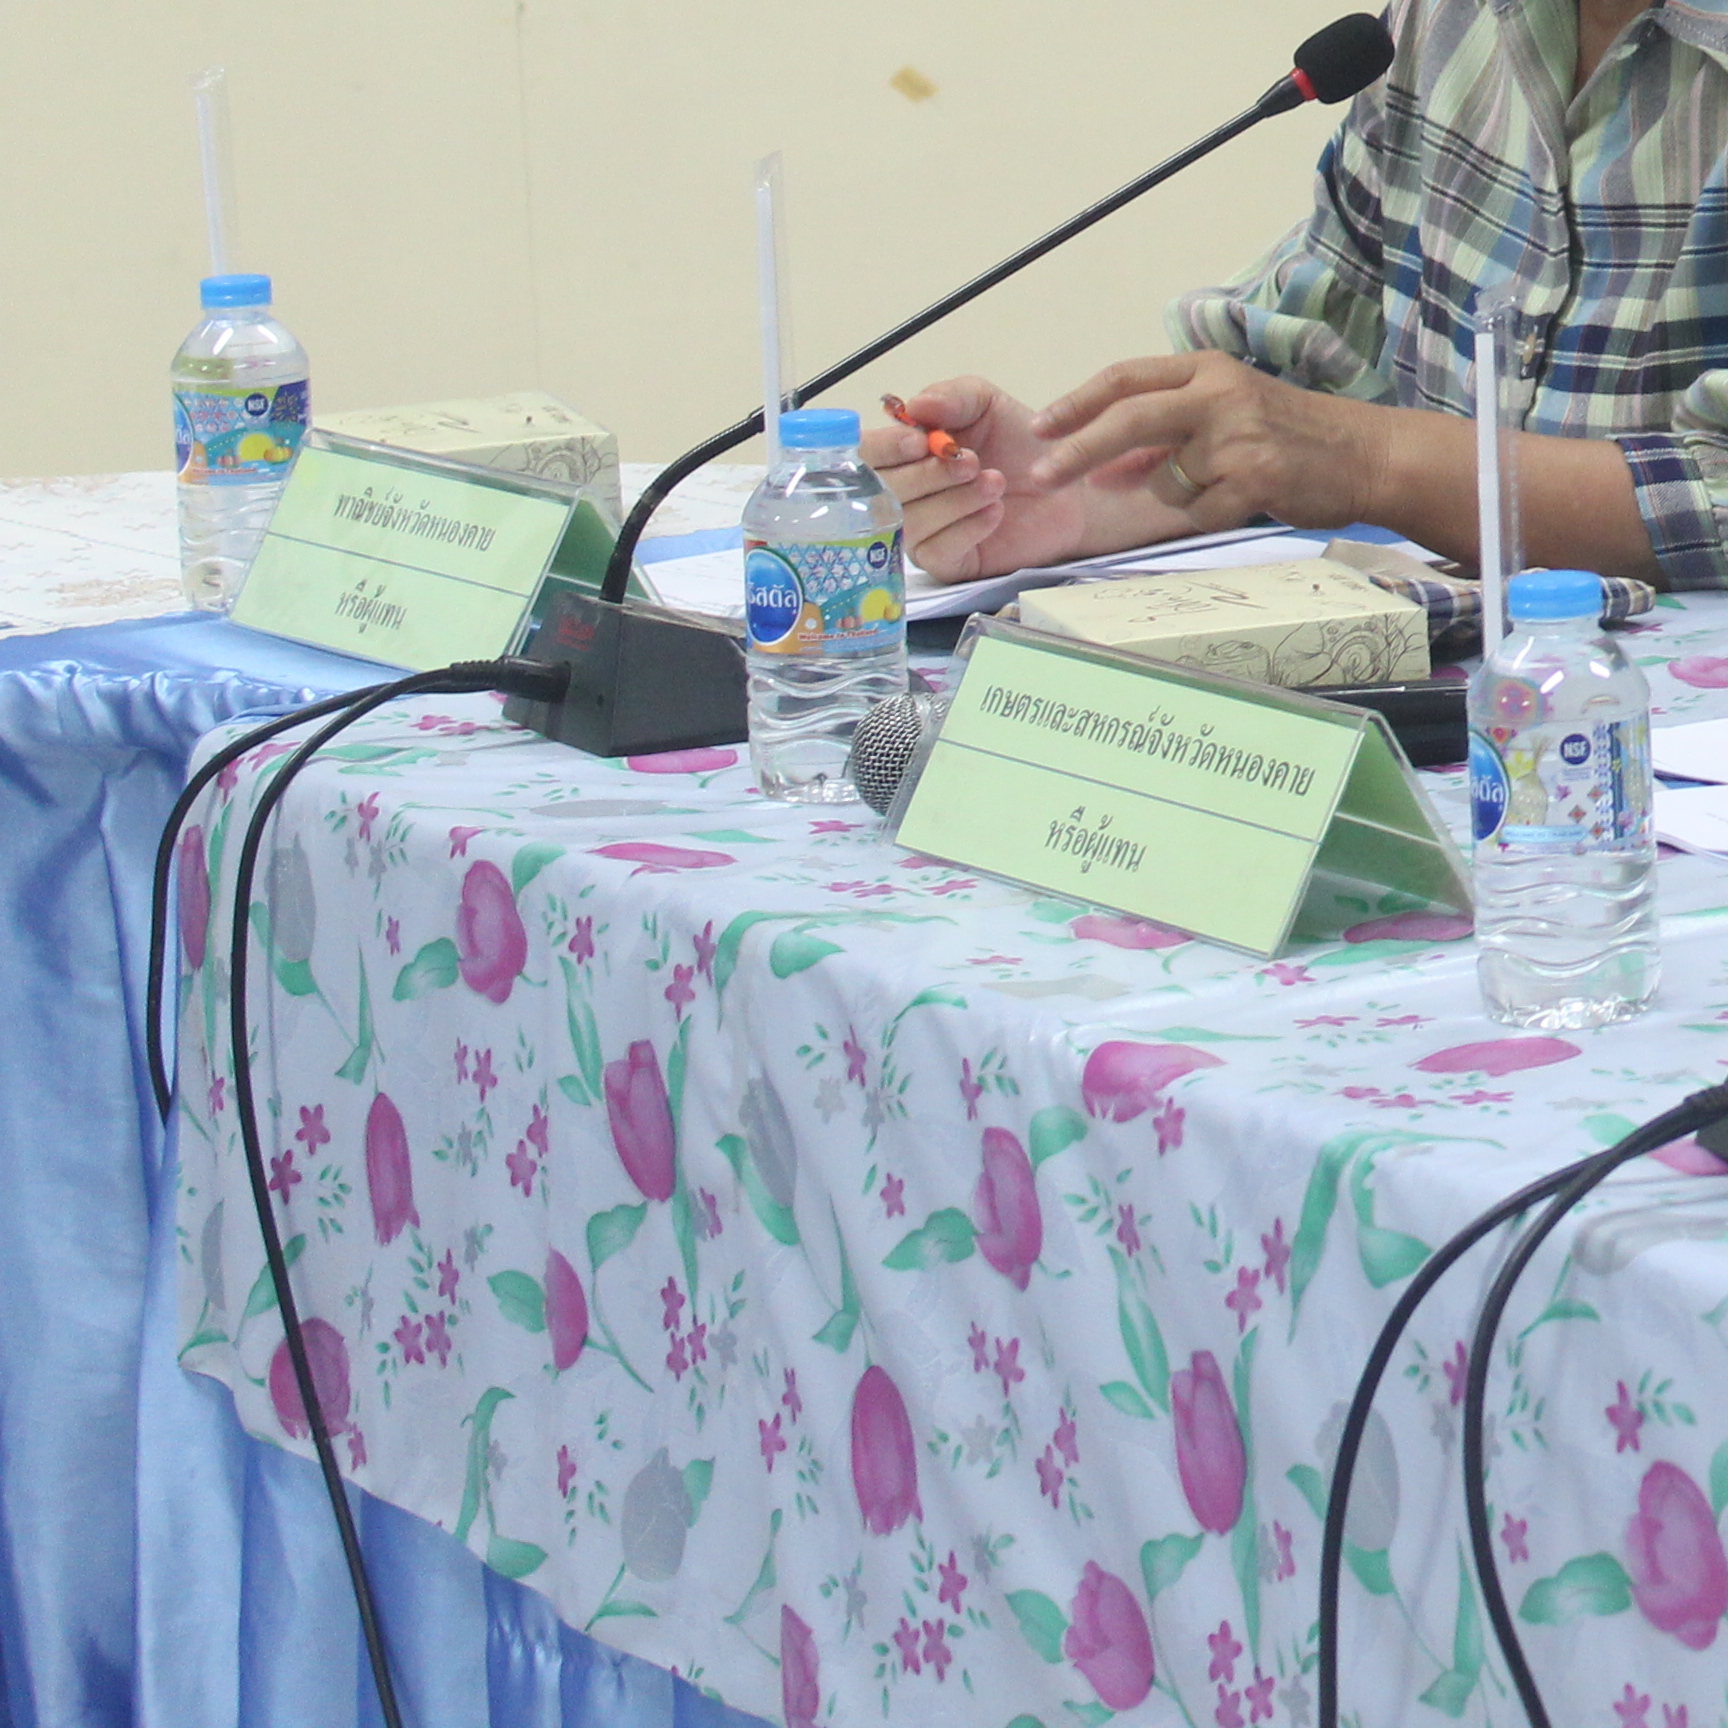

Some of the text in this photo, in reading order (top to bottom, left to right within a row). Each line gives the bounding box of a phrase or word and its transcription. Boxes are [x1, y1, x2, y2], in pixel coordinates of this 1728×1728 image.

[334, 486, 496, 552] พาณิชย์จังหวัดหนองคาย
[335, 579, 407, 634] หรือผู้แทน
[980, 685, 1316, 797] เกษตรและสหกรณ์จังหวัดหนองคาย
[1563, 741, 1588, 760] NSF
[1045, 806, 1148, 874] หรือผู้แทน
